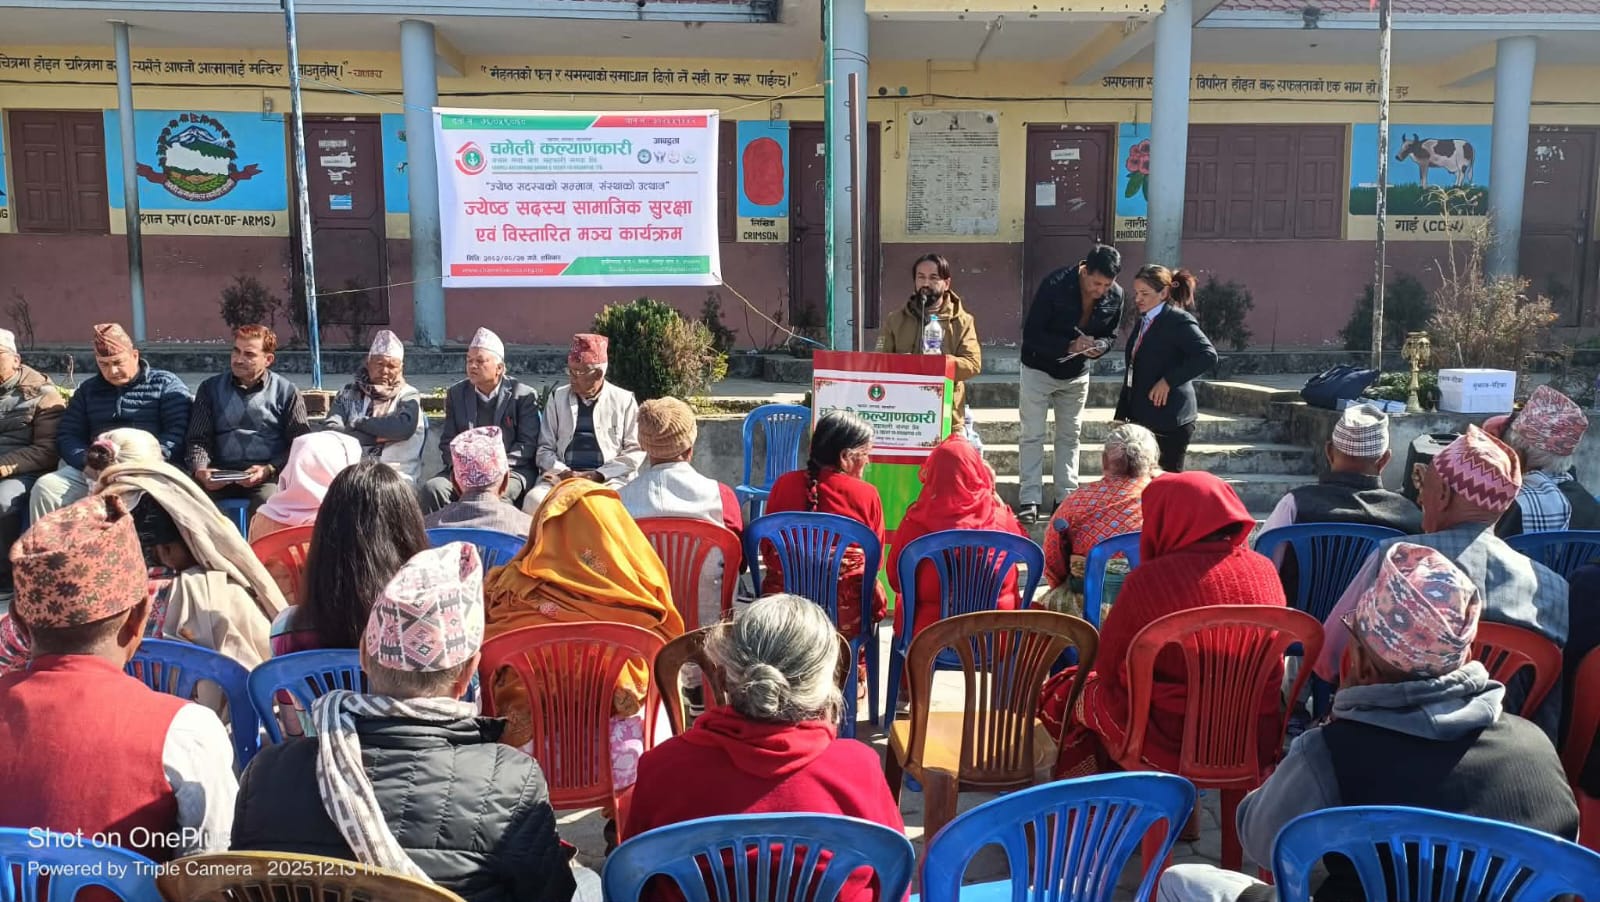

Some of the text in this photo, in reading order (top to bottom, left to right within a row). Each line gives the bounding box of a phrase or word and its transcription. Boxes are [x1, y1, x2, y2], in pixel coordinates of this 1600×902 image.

[248, 59, 284, 75] मन्दिर
[715, 72, 729, 86] तर
[490, 138, 632, 155] चमेली कल्याणकारी
[517, 180, 557, 191] सदस्यको
[598, 179, 636, 191] संस्थाको
[464, 196, 693, 220] ज्येष्ठ सदस्य सामाजिक सुरक्षा
[188, 213, 276, 227] (COAT-OF-ARMS)
[475, 223, 683, 242] एवं विस्तारित मञ्च कार्यक्रम
[743, 231, 779, 240] CRIMSON
[857, 409, 937, 424] कल्याणकारी
